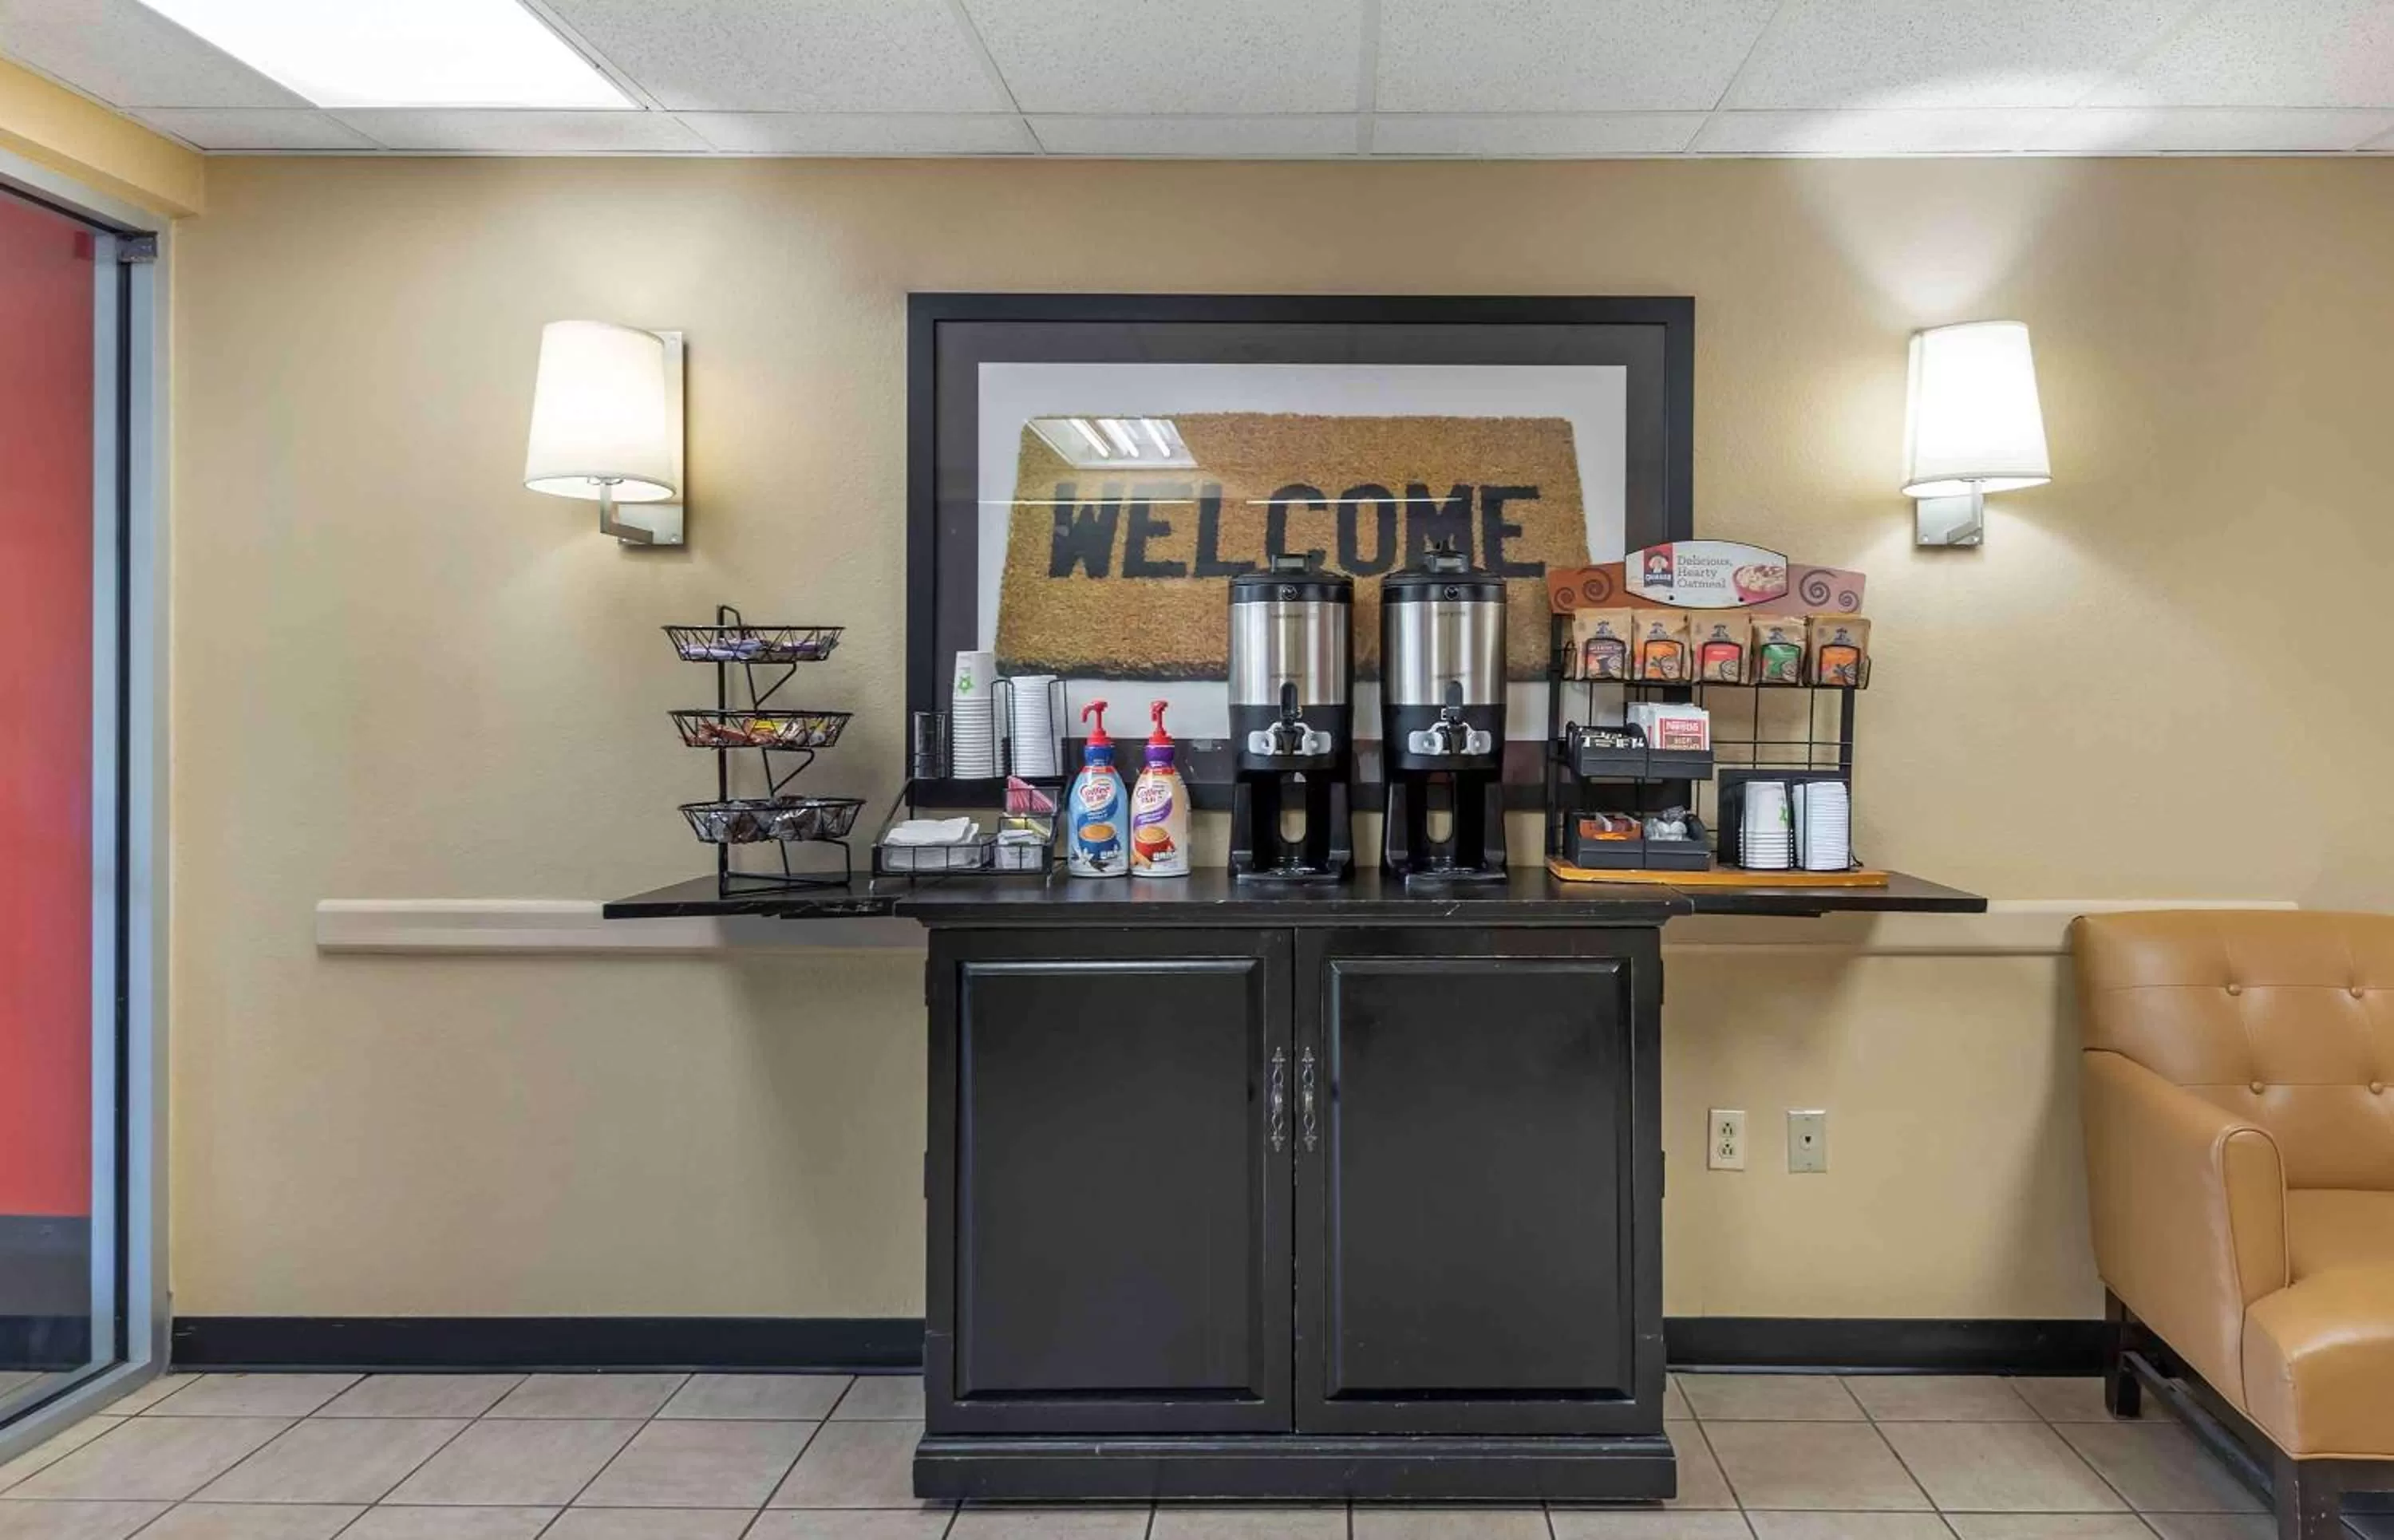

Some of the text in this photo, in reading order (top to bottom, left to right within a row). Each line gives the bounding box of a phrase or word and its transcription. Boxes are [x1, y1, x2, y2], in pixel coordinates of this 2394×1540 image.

[1049, 484, 1546, 578] WELCOME
[1677, 555, 1733, 567] Delicious,
[1677, 568, 1717, 578] Hearty
[1677, 578, 1726, 588] Oatmeal
